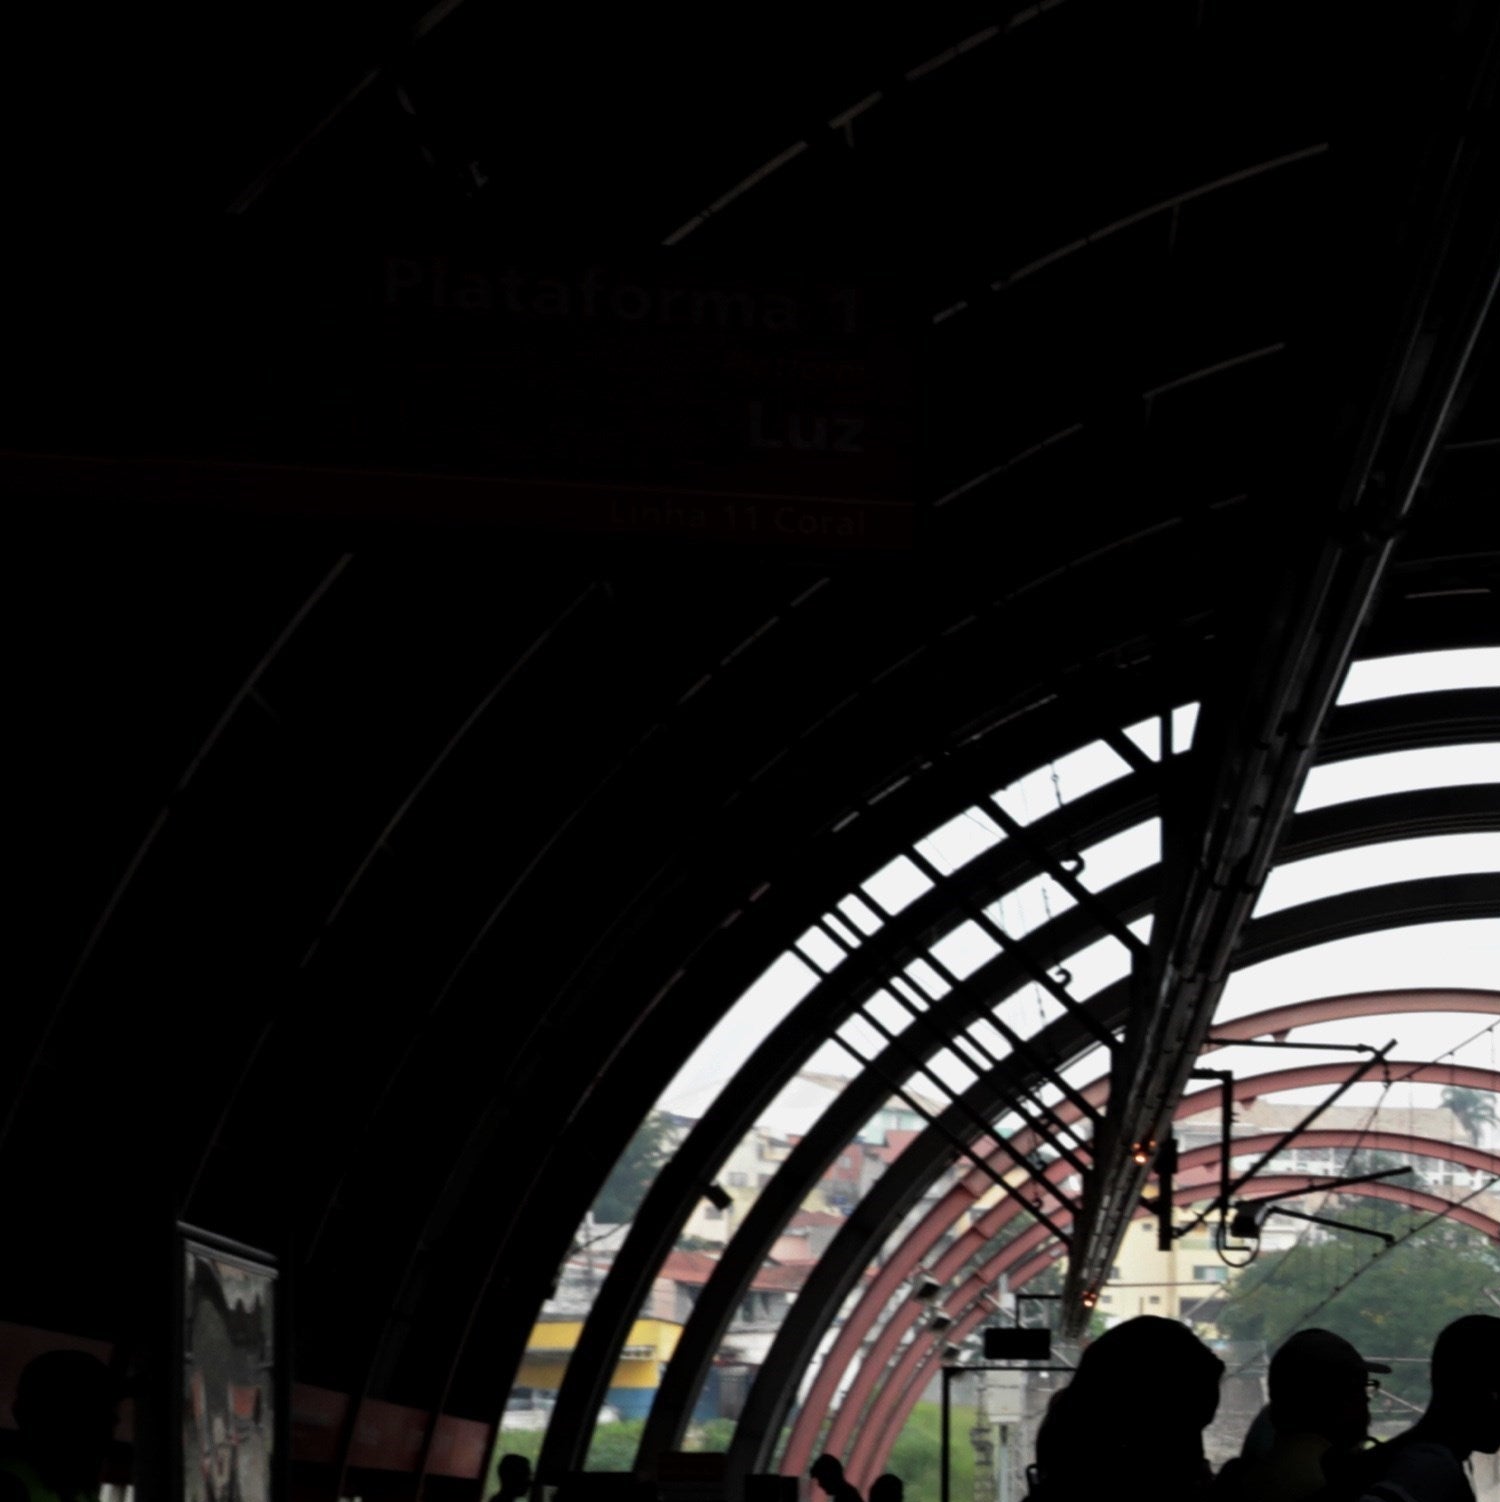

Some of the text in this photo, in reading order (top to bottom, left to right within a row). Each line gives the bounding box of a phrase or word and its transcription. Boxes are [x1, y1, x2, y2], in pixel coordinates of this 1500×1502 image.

[383, 256, 865, 335] Plataforma 1
[744, 398, 866, 454] Luz
[609, 498, 867, 538] Linha 11 Coral
